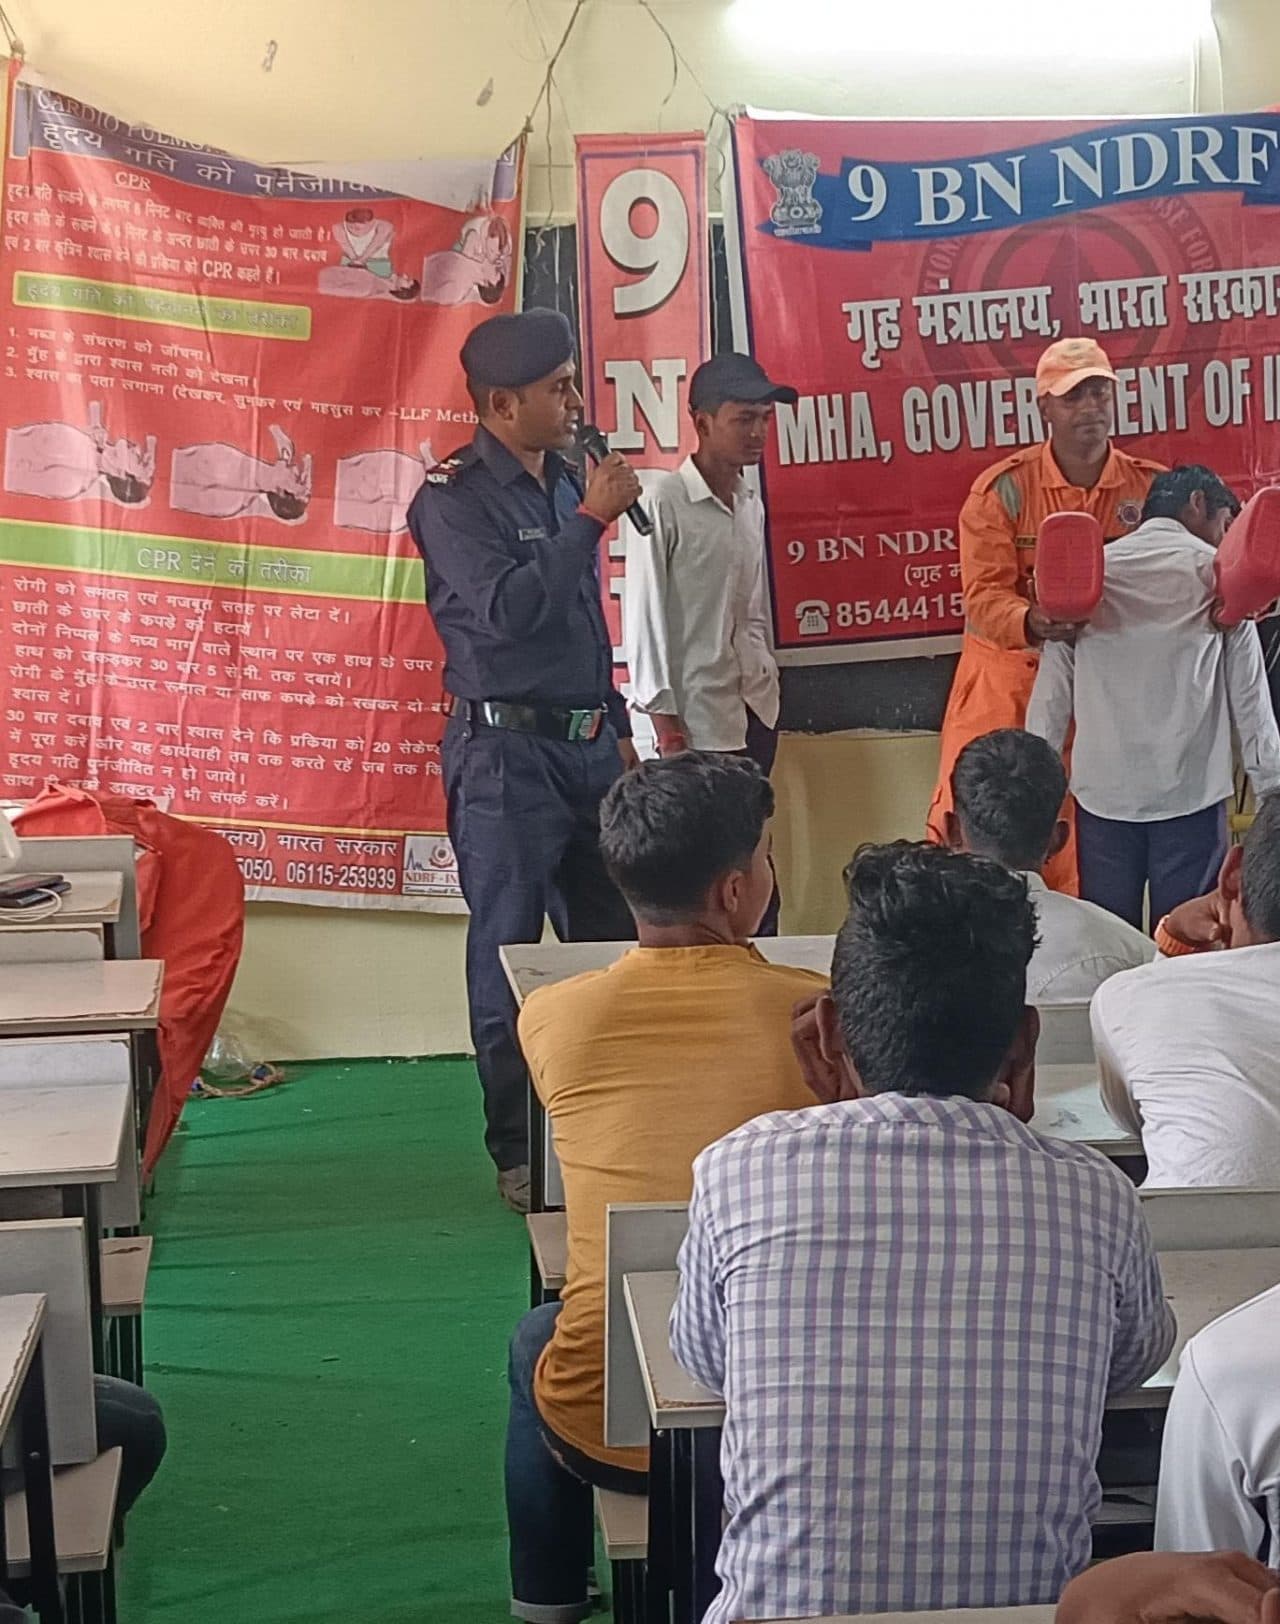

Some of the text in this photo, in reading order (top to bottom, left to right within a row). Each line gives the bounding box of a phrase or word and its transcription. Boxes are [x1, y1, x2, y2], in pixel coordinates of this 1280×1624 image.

[41, 121, 103, 149] हृदय
[196, 161, 236, 185] को
[114, 171, 151, 191] CPR
[847, 124, 1279, 228] 9 BN NDRF
[599, 168, 690, 317] 9
[202, 260, 233, 280] CPR
[842, 299, 901, 368] गृह
[911, 278, 1062, 345] मंत्रालय,
[1078, 275, 1169, 333] भारत
[436, 410, 479, 425] Meth
[774, 391, 893, 467] MHA,
[903, 360, 1189, 455] GOVERENT
[1203, 360, 1251, 427] OF
[137, 547, 182, 571] CPR
[787, 527, 960, 566] 9 BN NDR
[836, 592, 967, 628] 8544415
[151, 658, 169, 672] 30
[207, 664, 217, 677] 5
[6, 708, 25, 722] 30
[137, 720, 149, 733] 2
[372, 741, 391, 754] 20
[277, 834, 399, 858] भारत सरकार
[287, 861, 397, 891] 06115-253939
